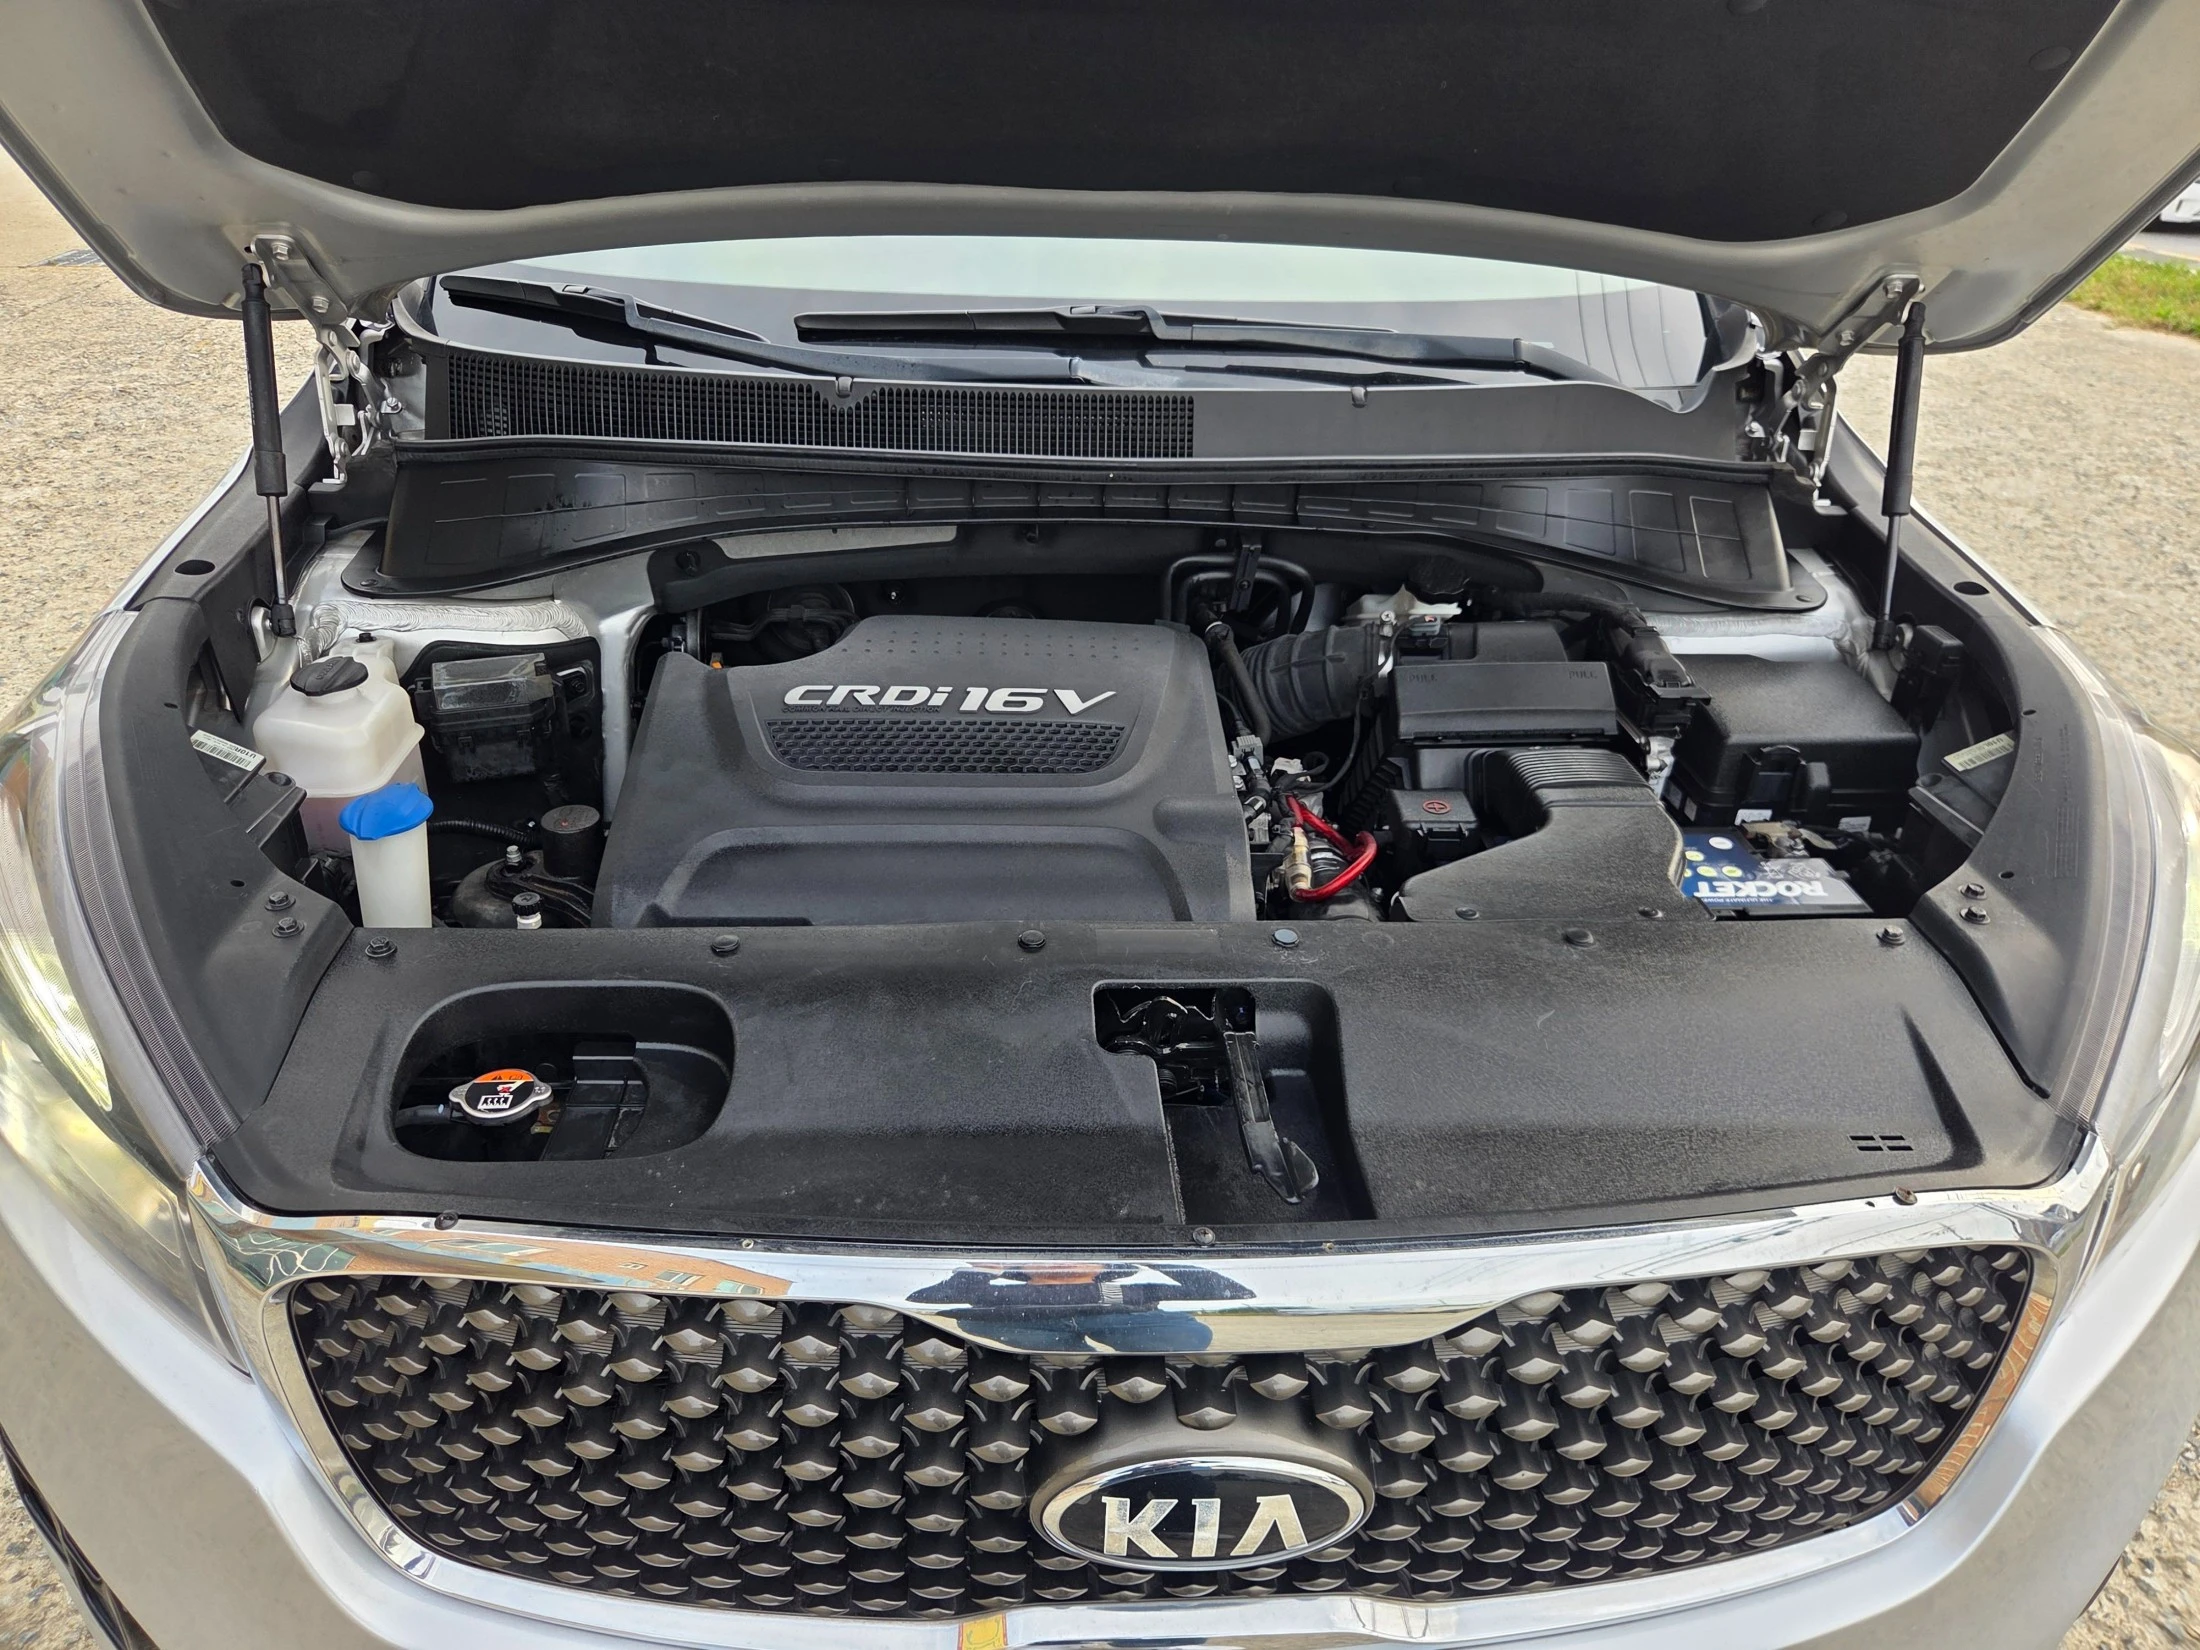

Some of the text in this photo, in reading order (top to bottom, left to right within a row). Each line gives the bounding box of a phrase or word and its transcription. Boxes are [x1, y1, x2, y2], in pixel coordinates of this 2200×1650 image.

[784, 685, 954, 706] CRDi
[1693, 880, 1828, 898] ROCKET
[1101, 1494, 1309, 1558] KIA
